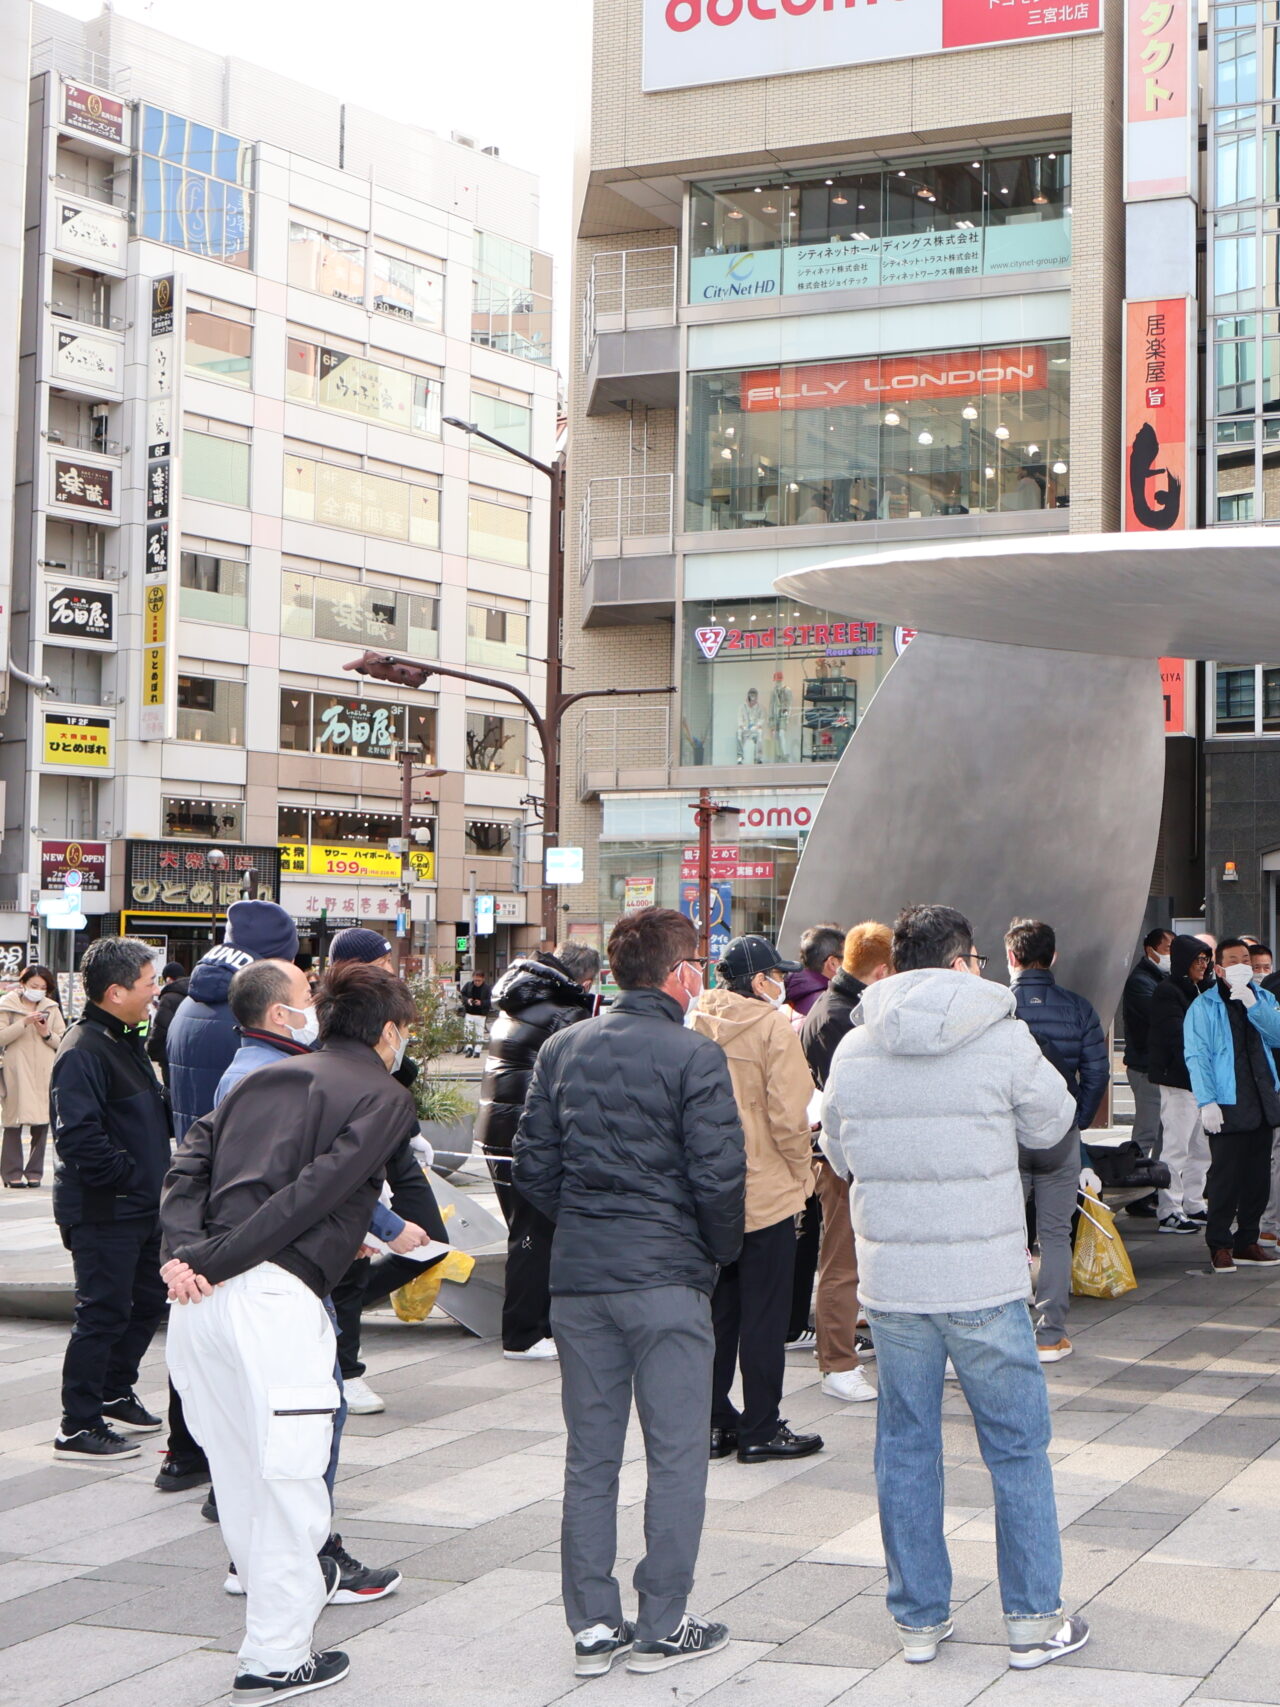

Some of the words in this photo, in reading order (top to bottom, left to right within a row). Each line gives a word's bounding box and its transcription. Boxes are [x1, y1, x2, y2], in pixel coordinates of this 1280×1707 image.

[1027, 3, 1089, 25] 三宮北店
[797, 231, 980, 261] シティネットホールディングス株式会社
[882, 251, 979, 269] シティネット・トラスト株式会社
[990, 255, 1070, 271] www.citynet-group.jp/
[797, 263, 869, 278] シティネット株式会社
[882, 265, 979, 283] シティネットワークス有限会社
[703, 283, 753, 301] CityNet
[754, 279, 776, 294] HD
[797, 276, 869, 290] 株式会社ジョイテック
[1145, 314, 1166, 383] 居楽屋
[322, 353, 339, 368] 6F
[863, 364, 1034, 393] LONDON
[154, 445, 165, 457] 6F
[58, 466, 104, 506] 楽蔵
[56, 492, 68, 501] 4F
[51, 597, 110, 629] 石田屋
[330, 591, 388, 641] 楽蔵
[726, 627, 776, 650] 2nd
[782, 622, 878, 647] STREET
[854, 646, 879, 656] Shop
[390, 705, 404, 715] 3F
[66, 717, 77, 725] 1F
[78, 718, 89, 726] 2F
[320, 704, 397, 746] 石田屋
[49, 741, 107, 755] ひとめぼれ
[42, 852, 65, 862] NEW
[81, 854, 105, 863] OPEN
[324, 849, 348, 857] サワー
[354, 851, 392, 860] ハイボール
[326, 860, 368, 875] 199円
